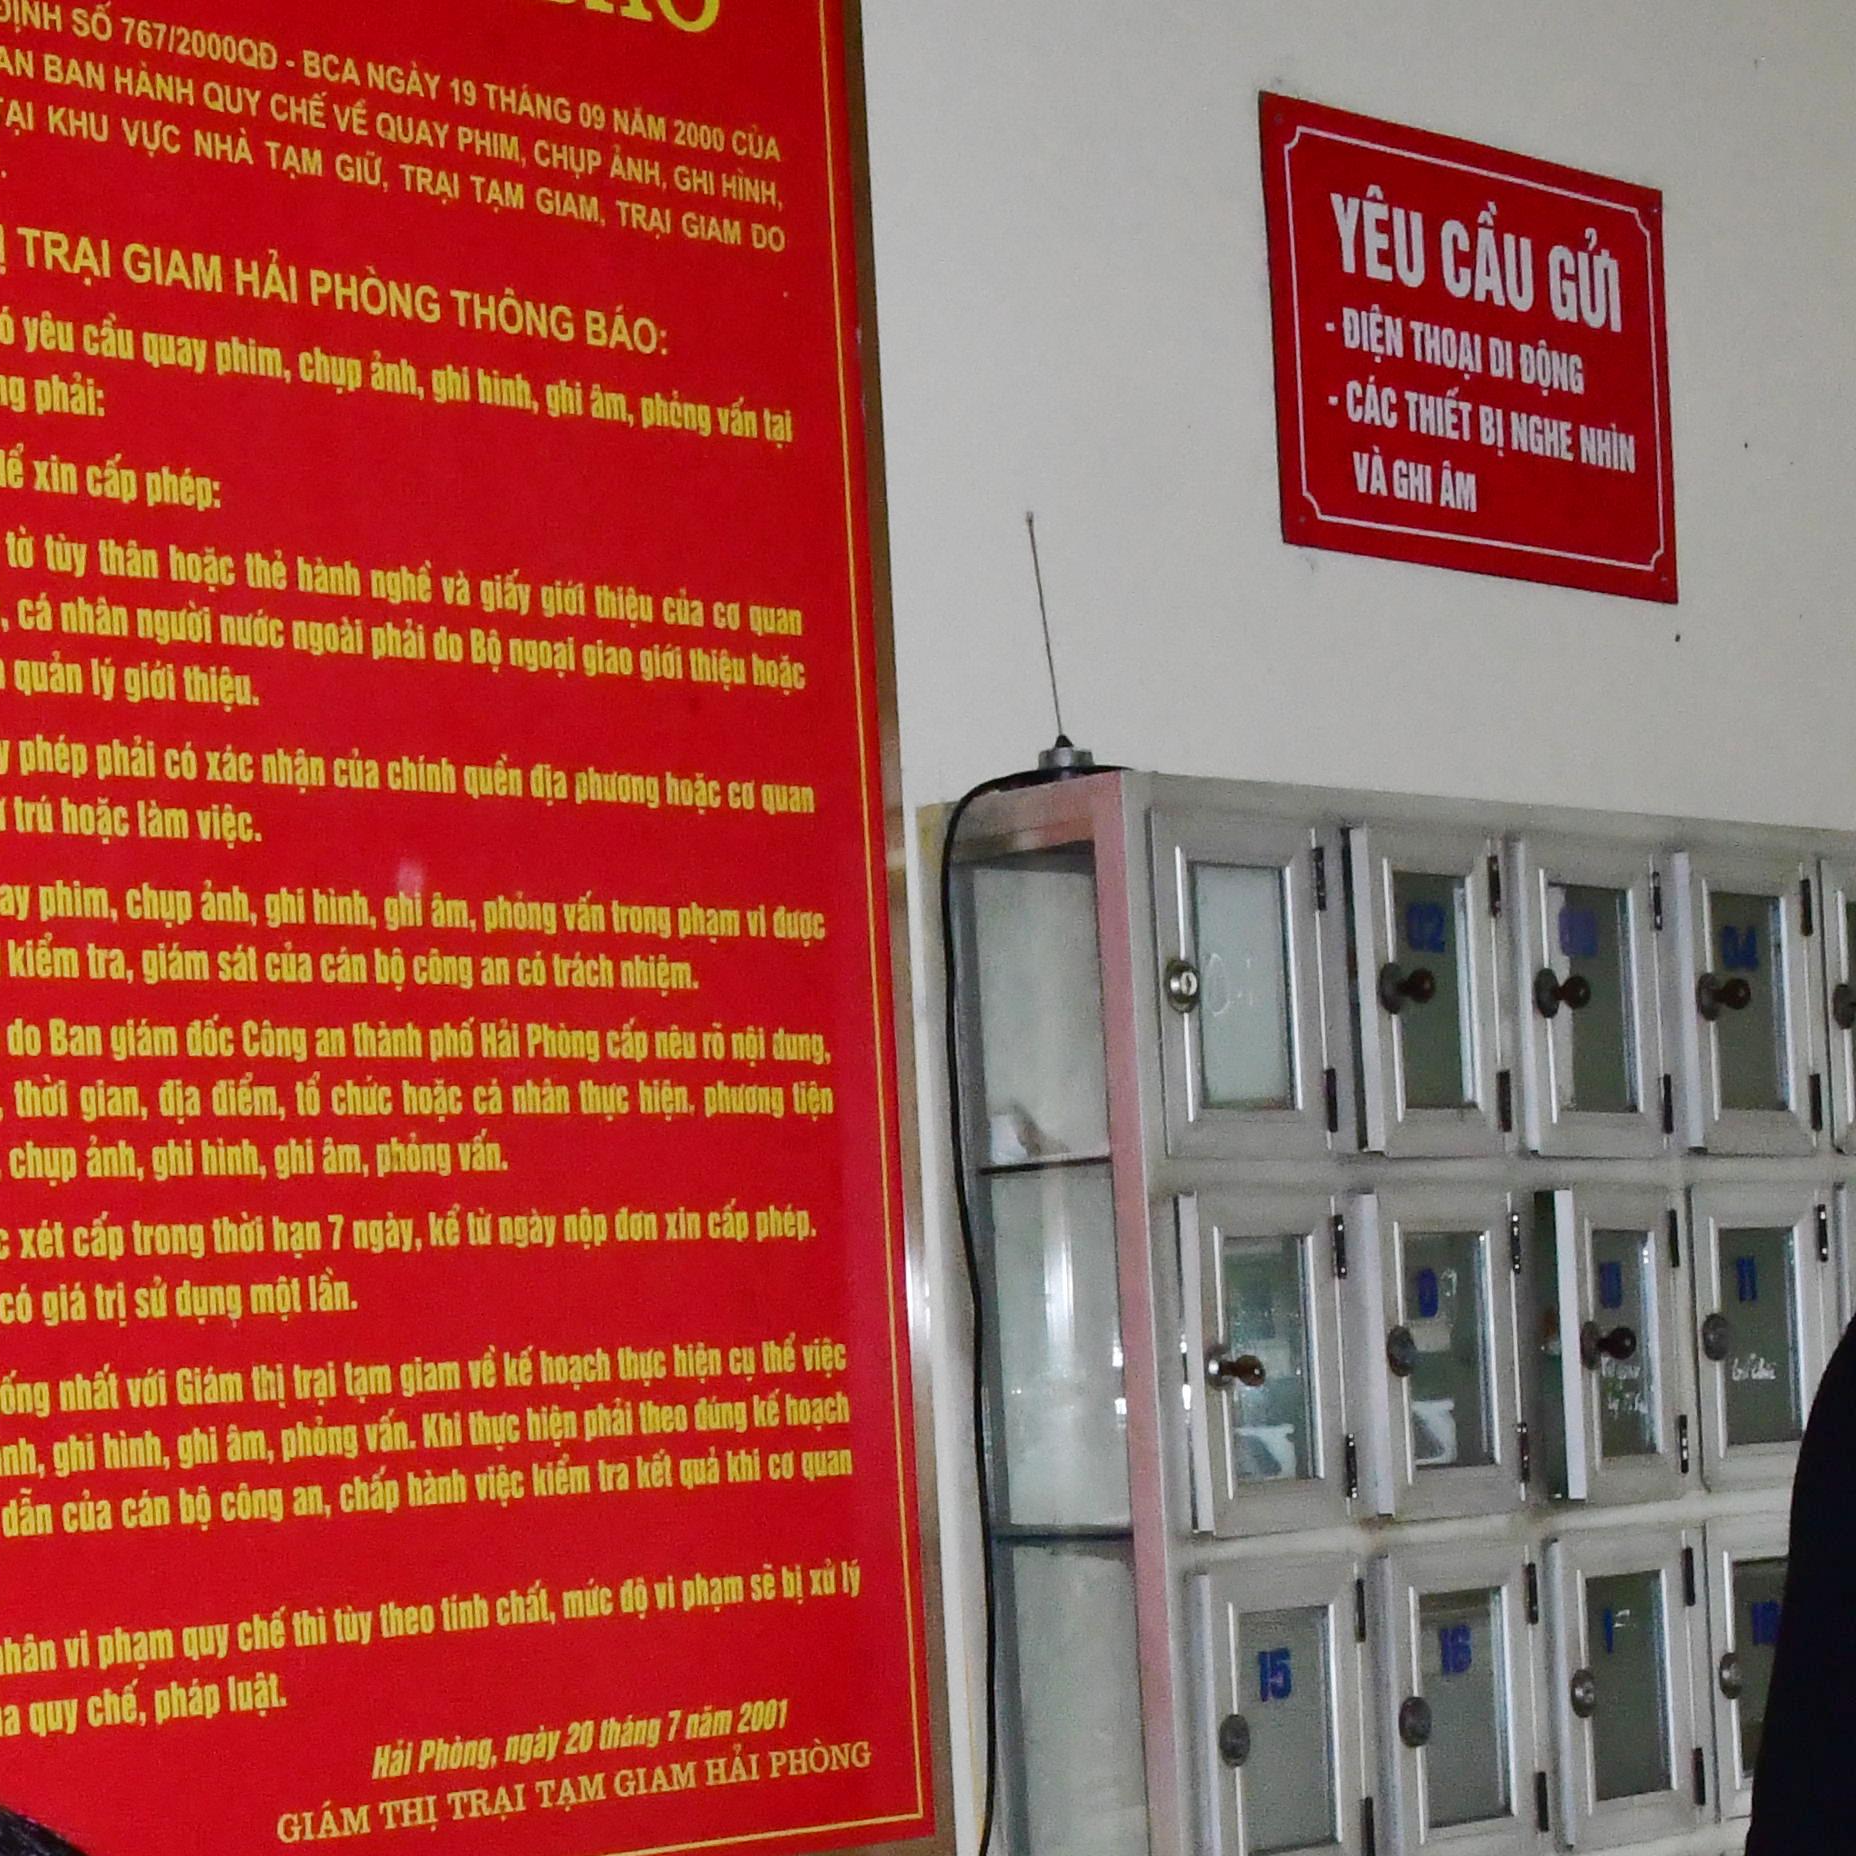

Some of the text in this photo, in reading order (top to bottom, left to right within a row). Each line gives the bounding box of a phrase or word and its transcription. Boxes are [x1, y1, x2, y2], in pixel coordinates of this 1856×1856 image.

[16, 226, 111, 278] TRẠI
[122, 242, 223, 293] GIAM
[234, 248, 298, 304] HẢI
[309, 265, 441, 324] PHÒNG
[449, 287, 575, 342] THÔNG
[585, 304, 668, 356] BÁO:
[1330, 184, 1622, 333] YÊU CẦU GỬI
[1342, 303, 1404, 363] ĐIỆN
[1409, 320, 1483, 380] THOẠI
[1489, 337, 1514, 380] DI
[1519, 339, 1585, 397] ĐỘNG
[1346, 376, 1398, 429] CÁC
[1404, 388, 1473, 441] THIẾT
[1479, 405, 1505, 456] BỊ
[1510, 411, 1574, 462] NGHE
[1579, 423, 1636, 474] NHÌN
[32, 454, 79, 495] xin
[85, 452, 138, 505] cấp
[145, 465, 222, 512] phép:
[1352, 447, 1477, 513] VÀ GHI ÂM
[1260, 1646, 1299, 1703] 15
[1437, 1622, 1474, 1677] 16
[276, 1738, 872, 1844] GIÁM THỊ TRẠI TẠM GIAM HẢI PHÒNG
